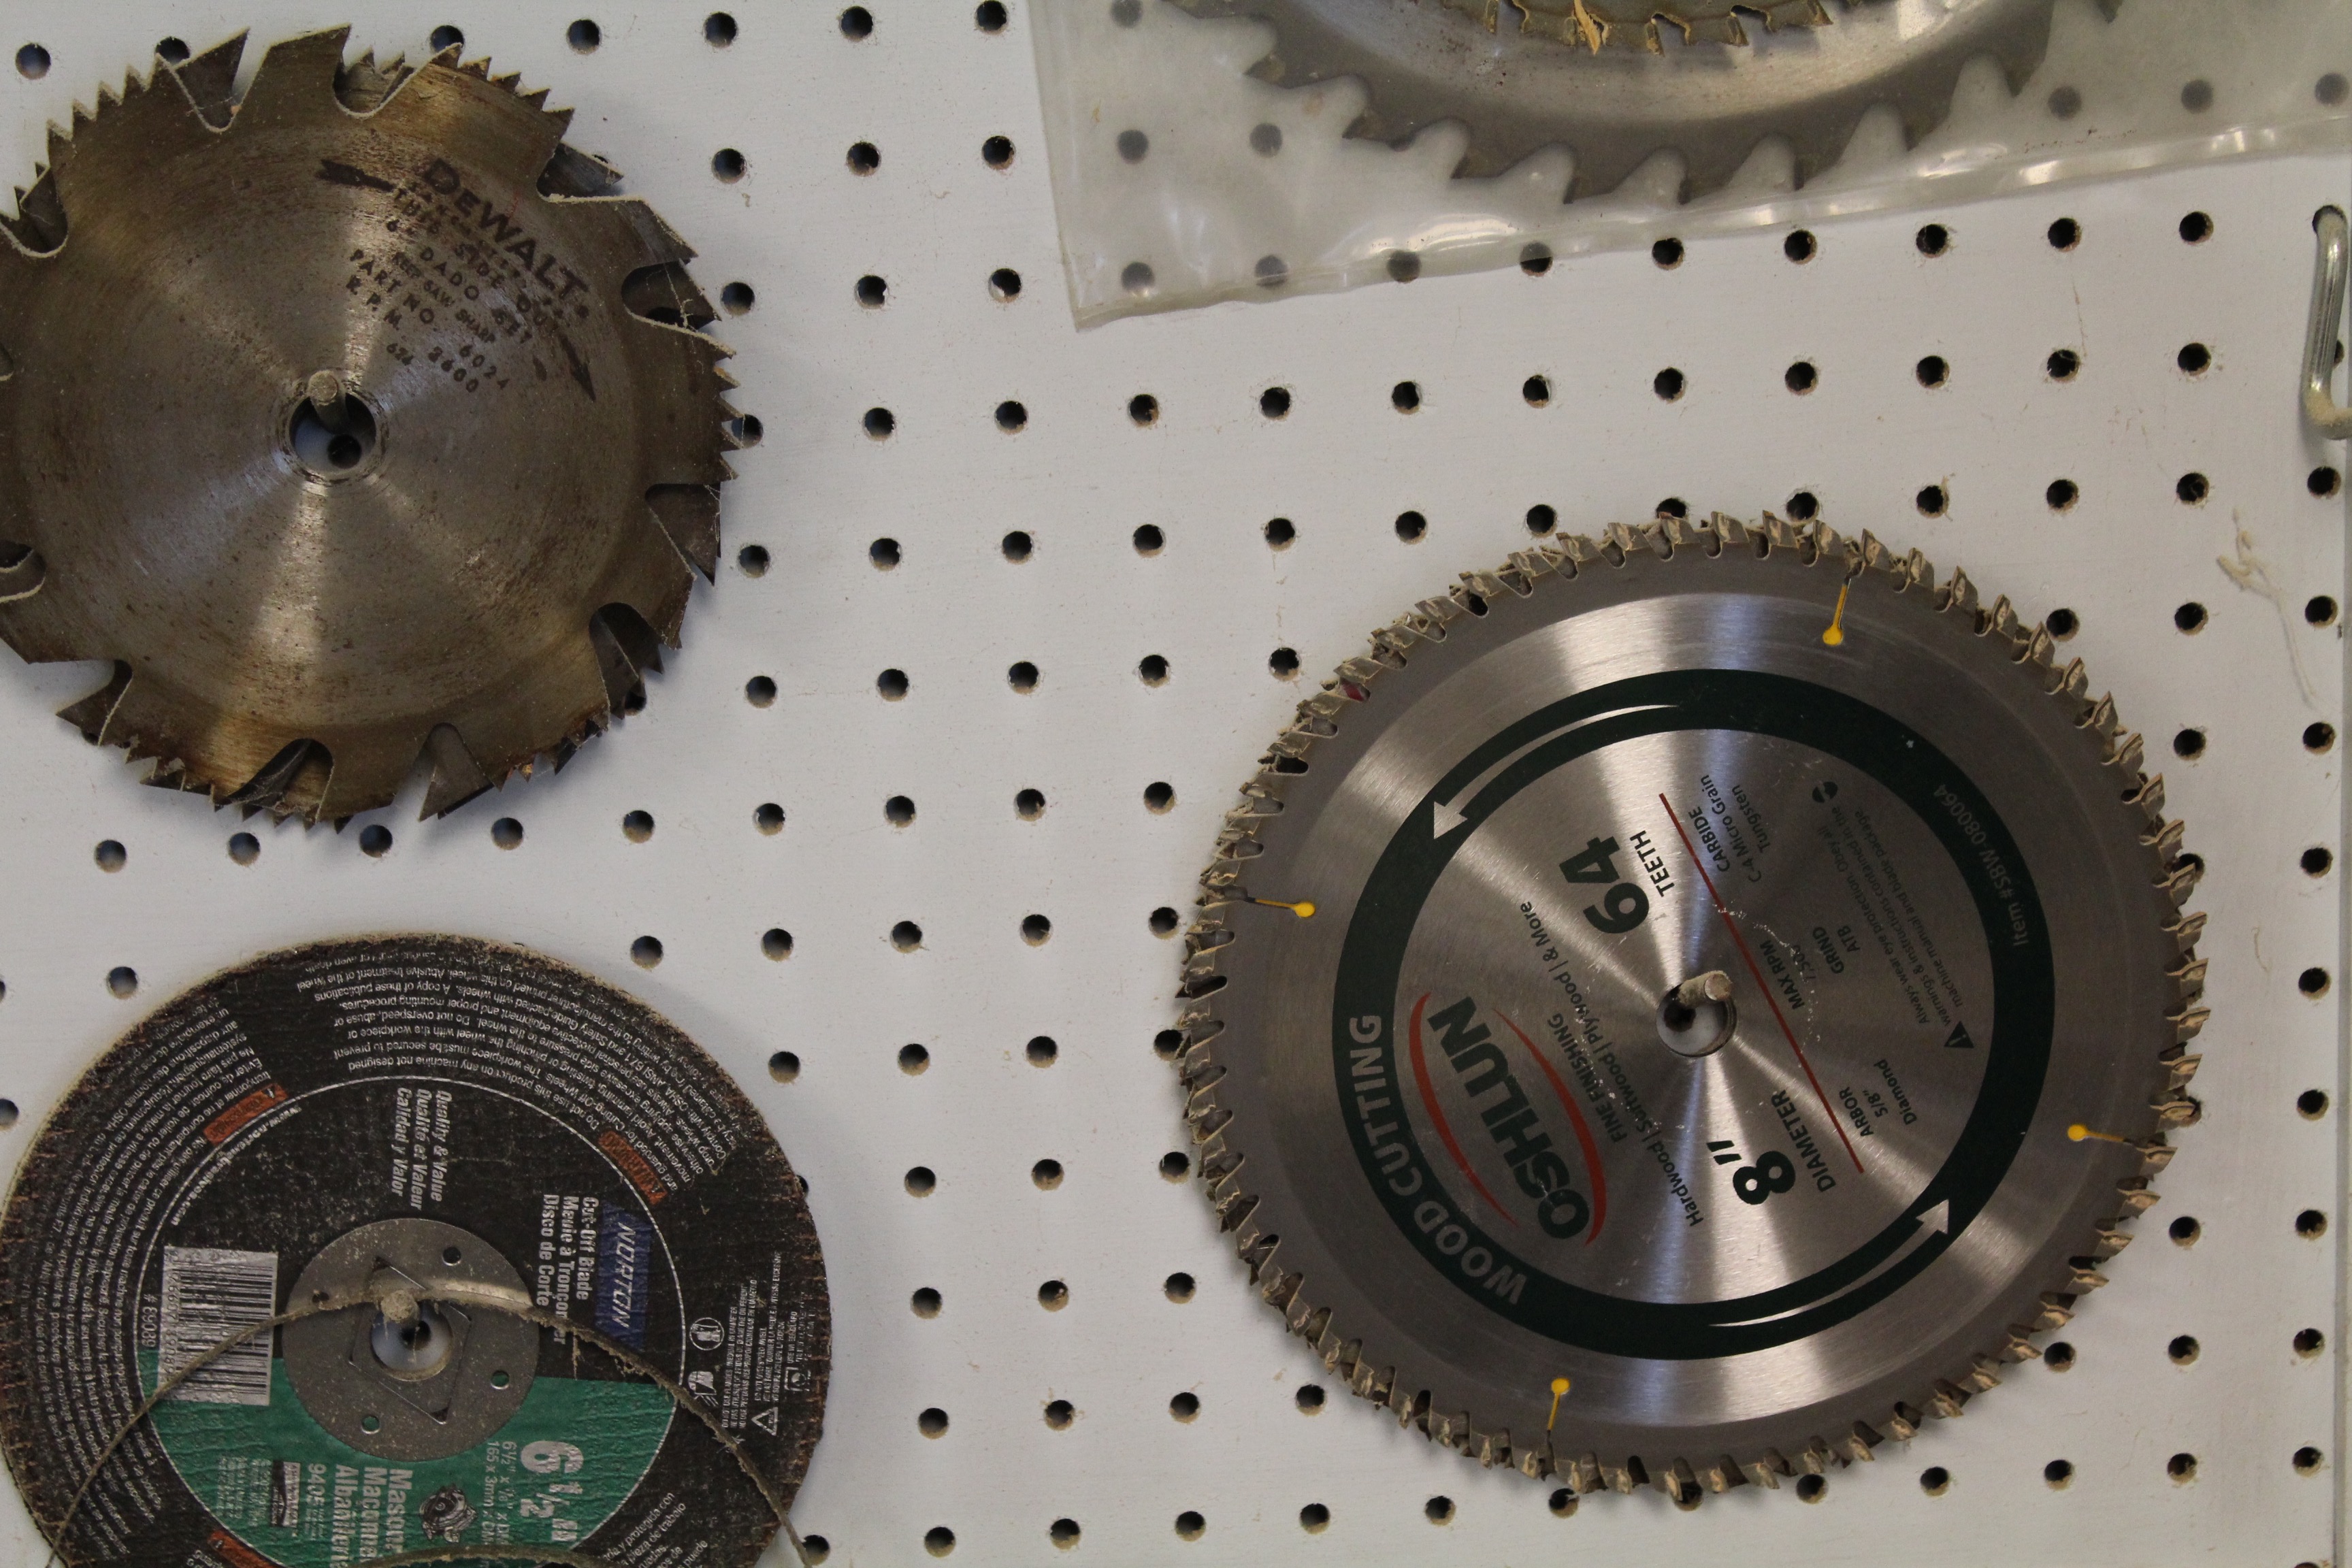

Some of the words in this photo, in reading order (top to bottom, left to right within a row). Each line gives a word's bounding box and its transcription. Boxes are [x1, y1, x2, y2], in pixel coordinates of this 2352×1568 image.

[348, 245, 402, 297] PART
[419, 244, 483, 304] DADO
[453, 239, 507, 291] SIDE
[390, 250, 424, 282] KEEP
[421, 277, 455, 310] SAW
[453, 306, 497, 348] SHARP
[1696, 773, 1727, 816] Grain
[1727, 782, 1776, 853] Tungsten
[1816, 825, 1832, 843] all
[1827, 805, 1846, 828] the
[1839, 826, 1853, 840] in
[1688, 805, 1733, 873] CARBIDE
[1718, 814, 1750, 858] Micro
[1932, 781, 2016, 901] #SBW-080064
[1629, 829, 1676, 898] TEETH
[1824, 838, 1851, 873] Obey
[1845, 838, 1884, 899] contained
[1553, 828, 1657, 946] 64
[1876, 858, 1902, 894] blade
[1842, 871, 1885, 936] protection.
[1895, 892, 1914, 916] and
[1515, 897, 1552, 947] More
[1836, 924, 1861, 955] ATB
[1876, 896, 1919, 965] instructions
[1906, 913, 1938, 960] manual
[2002, 901, 2030, 947] Item
[1541, 946, 1559, 964] &
[1759, 938, 1786, 974] RPM
[1810, 924, 1846, 976] GRIND
[1876, 932, 1897, 956] eye
[1888, 956, 1910, 985] wear
[1912, 963, 1925, 975] &
[1929, 958, 1964, 1009] machine
[1552, 968, 1607, 1045] Plywood
[1776, 971, 1806, 1010] MAX
[1900, 983, 1933, 1026] Always
[1917, 973, 1954, 1027] warnings
[332, 1017, 344, 1027] or
[345, 1012, 376, 1026] abuse
[346, 1030, 357, 1039] or
[360, 1024, 411, 1039] workpiece
[414, 1025, 429, 1035] the
[433, 1026, 454, 1037] with
[436, 1012, 453, 1022] not
[455, 1014, 470, 1024] Do
[508, 1026, 525, 1039] the
[331, 1041, 371, 1060] prevent
[373, 1042, 383, 1052] to
[386, 1041, 426, 1051] secured
[428, 1041, 442, 1052] be
[442, 1043, 470, 1056] must
[456, 1029, 487, 1043] wheel
[487, 1034, 504, 1047] the
[504, 1038, 549, 1063] pinching
[525, 1031, 538, 1043] to
[538, 1034, 581, 1061] pressure
[347, 1055, 393, 1073] designed
[396, 1056, 412, 1065] not
[415, 1056, 458, 1069] machine
[459, 1058, 479, 1072] any
[470, 1045, 523, 1071] workpiece
[480, 1064, 494, 1075] on
[521, 1062, 542, 1079] The
[547, 1056, 559, 1067] or
[557, 1060, 598, 1089] twisting
[577, 1056, 600, 1074] side
[1546, 1011, 1606, 1103] FINISHING
[494, 1066, 534, 1090] product
[532, 1083, 552, 1099] this
[598, 1068, 642, 1105] excessive
[1597, 1049, 1654, 1134] Softwood
[1872, 1058, 1918, 1126] Diamond
[391, 1086, 415, 1143] Calidad
[411, 1088, 436, 1142] Qualité
[429, 1090, 453, 1142] Quality
[551, 1092, 570, 1108] use
[568, 1103, 587, 1119] not
[576, 1090, 627, 1132] Cutting-Off
[638, 1098, 676, 1136] applying
[1350, 1015, 1426, 1200] CUTTING
[1836, 1085, 1875, 1139] ARBOR
[583, 1114, 600, 1130] Do
[622, 1128, 638, 1143] for
[630, 1113, 657, 1139] Avoid
[1427, 993, 1597, 1248] OSHLUN
[1593, 1100, 1628, 1144] FINE
[390, 1143, 406, 1155] y
[412, 1143, 428, 1160] et
[432, 1145, 449, 1156] &
[633, 1138, 668, 1176] guarded
[669, 1132, 704, 1176] otherwise
[1769, 1088, 1837, 1193] DIAMETER
[389, 1158, 410, 1197] Valor
[408, 1163, 428, 1211] Valeur
[427, 1160, 448, 1202] Value
[660, 1173, 679, 1192] and
[1646, 1139, 1704, 1227] Hardwood
[539, 1193, 561, 1238] Disco
[558, 1194, 581, 1243] Meule
[577, 1196, 602, 1253] Cut-Off
[538, 1241, 557, 1260] de
[558, 1245, 576, 1257] à
[1408, 1194, 1531, 1307] WOOD
[534, 1264, 556, 1307] Corte
[573, 1256, 596, 1301] Blade
[606, 1222, 640, 1328] NORTON
[546, 1258, 576, 1345] Tronçoner
[485, 1440, 500, 1463] 165
[483, 1476, 497, 1507] 3mm
[617, 1541, 629, 1552] y
[623, 1505, 664, 1548] protegida
[657, 1490, 676, 1511] con
[624, 1537, 652, 1564] pieza
[646, 1529, 662, 1544] de
[657, 1499, 689, 1535] trabajo
[681, 1537, 709, 1567] puede
